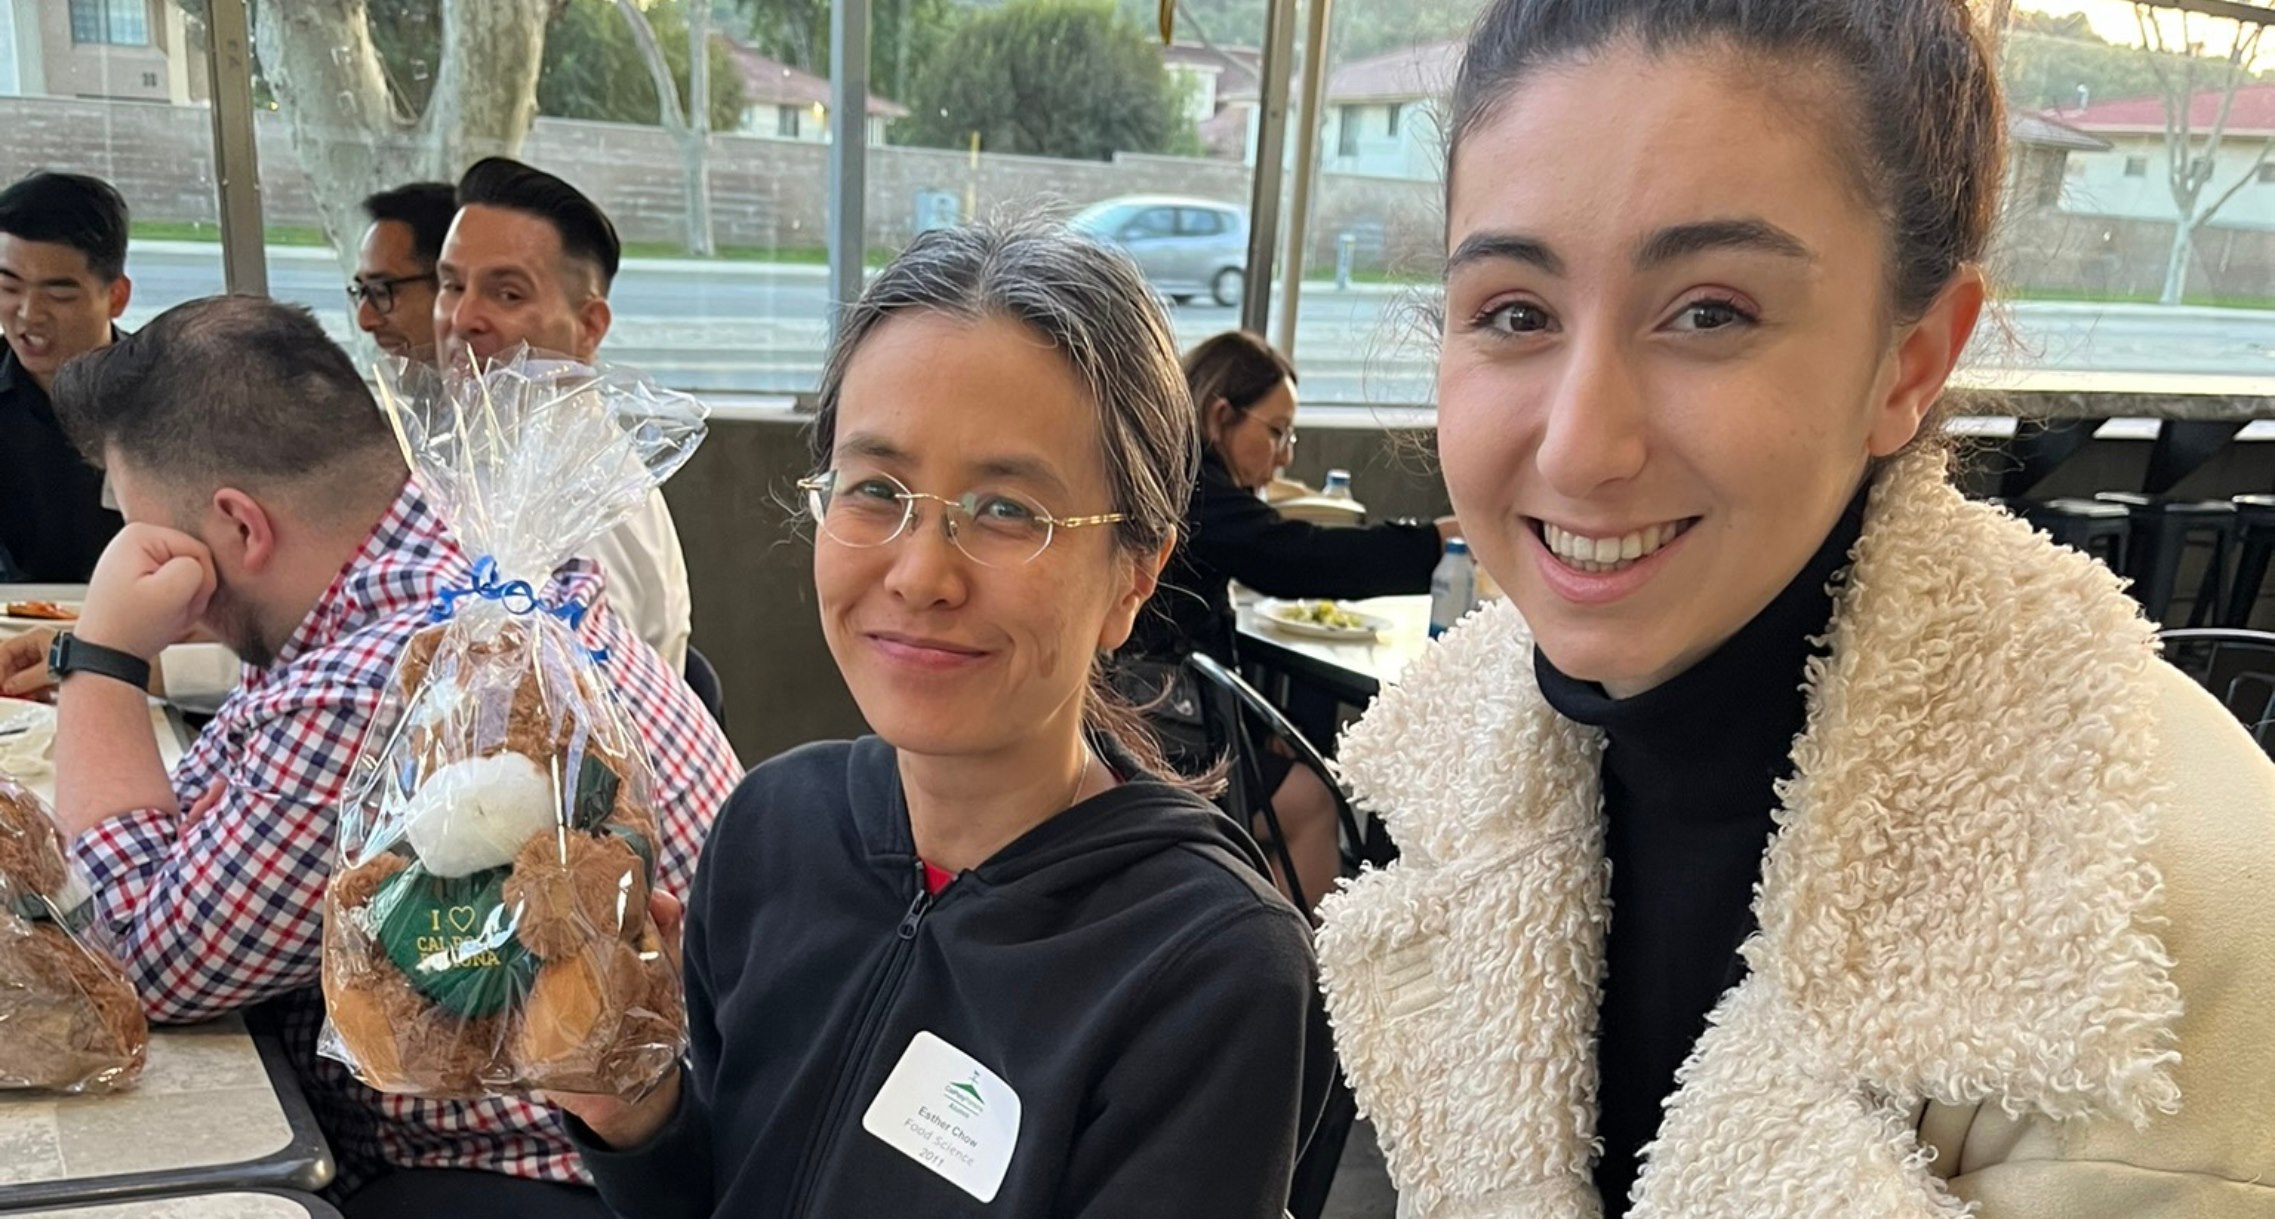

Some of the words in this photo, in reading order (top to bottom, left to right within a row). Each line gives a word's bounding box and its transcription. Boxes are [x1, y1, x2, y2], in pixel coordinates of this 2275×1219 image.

[431, 909, 440, 931] I
[416, 935, 445, 951] CAL
[918, 1106, 951, 1131] Esther
[951, 1126, 978, 1147] Chow
[904, 1118, 933, 1140] Food
[933, 1136, 974, 1166] Science
[919, 1147, 944, 1167] 2011
